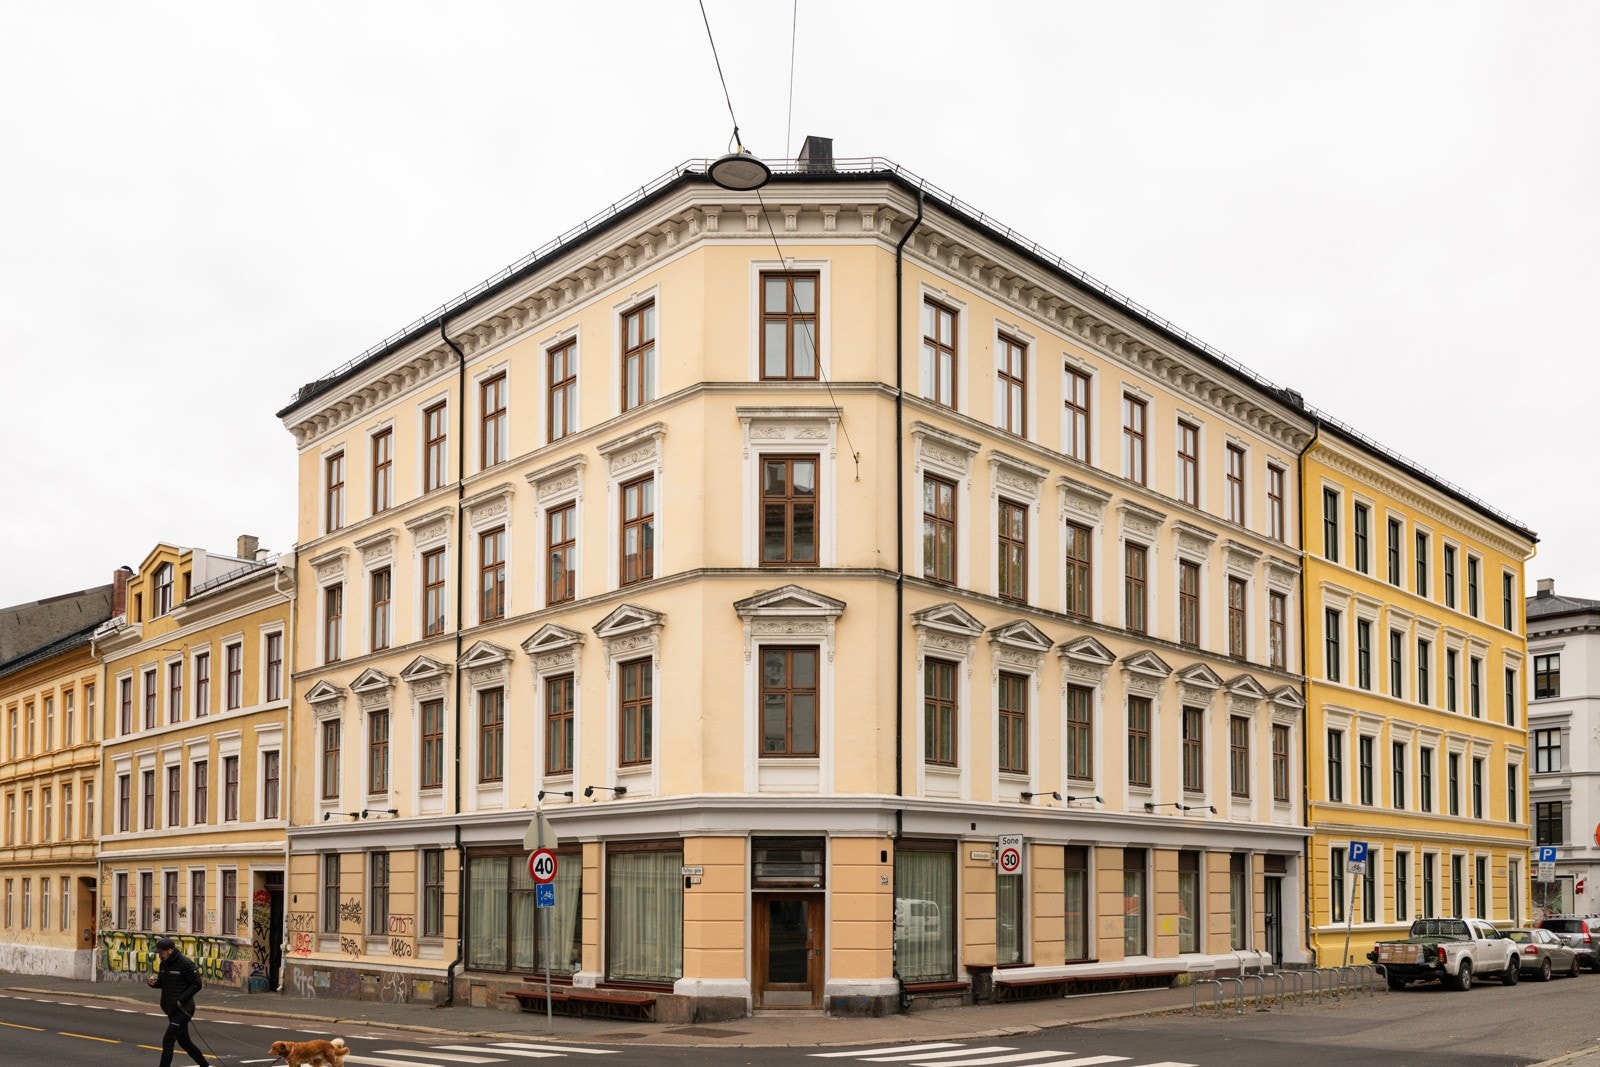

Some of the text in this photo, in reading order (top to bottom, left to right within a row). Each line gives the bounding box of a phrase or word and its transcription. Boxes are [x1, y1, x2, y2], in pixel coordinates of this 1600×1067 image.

[1002, 837, 1019, 845] Sone
[1353, 844, 1364, 859] P
[1543, 848, 1553, 860] P
[535, 857, 553, 874] 40
[1004, 854, 1017, 866] 30
